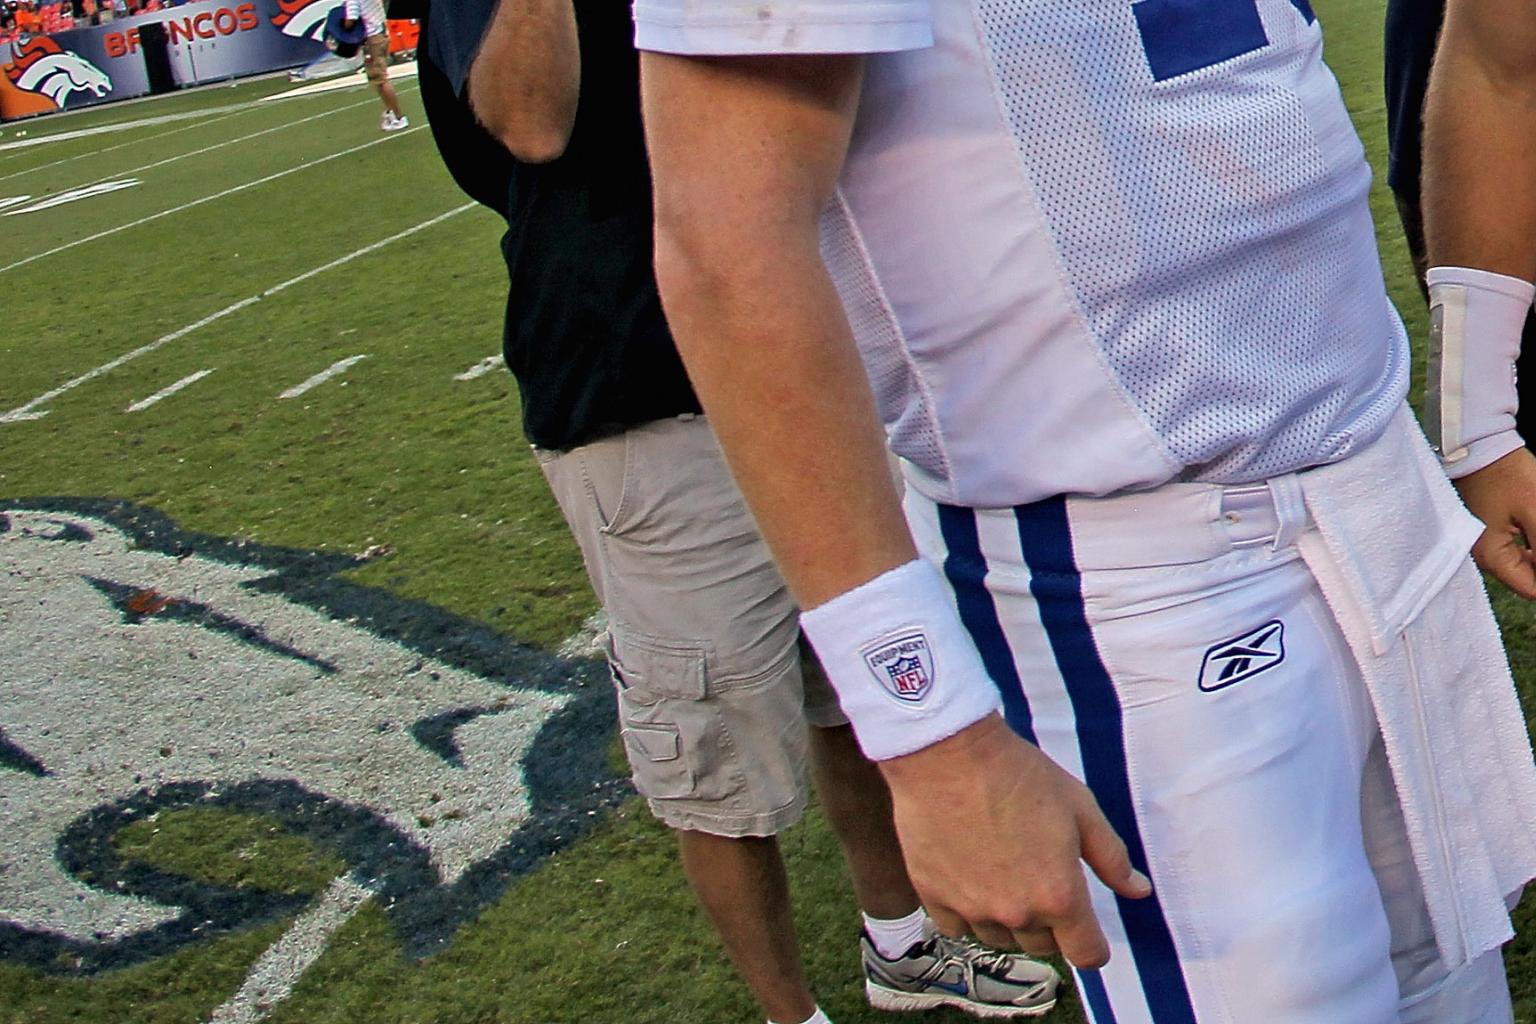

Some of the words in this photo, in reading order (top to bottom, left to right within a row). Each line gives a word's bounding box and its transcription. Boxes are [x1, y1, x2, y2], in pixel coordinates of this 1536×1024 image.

[104, 2, 260, 58] BRNCOS
[870, 639, 926, 668] EQUIPMENT
[894, 670, 927, 692] NFL
